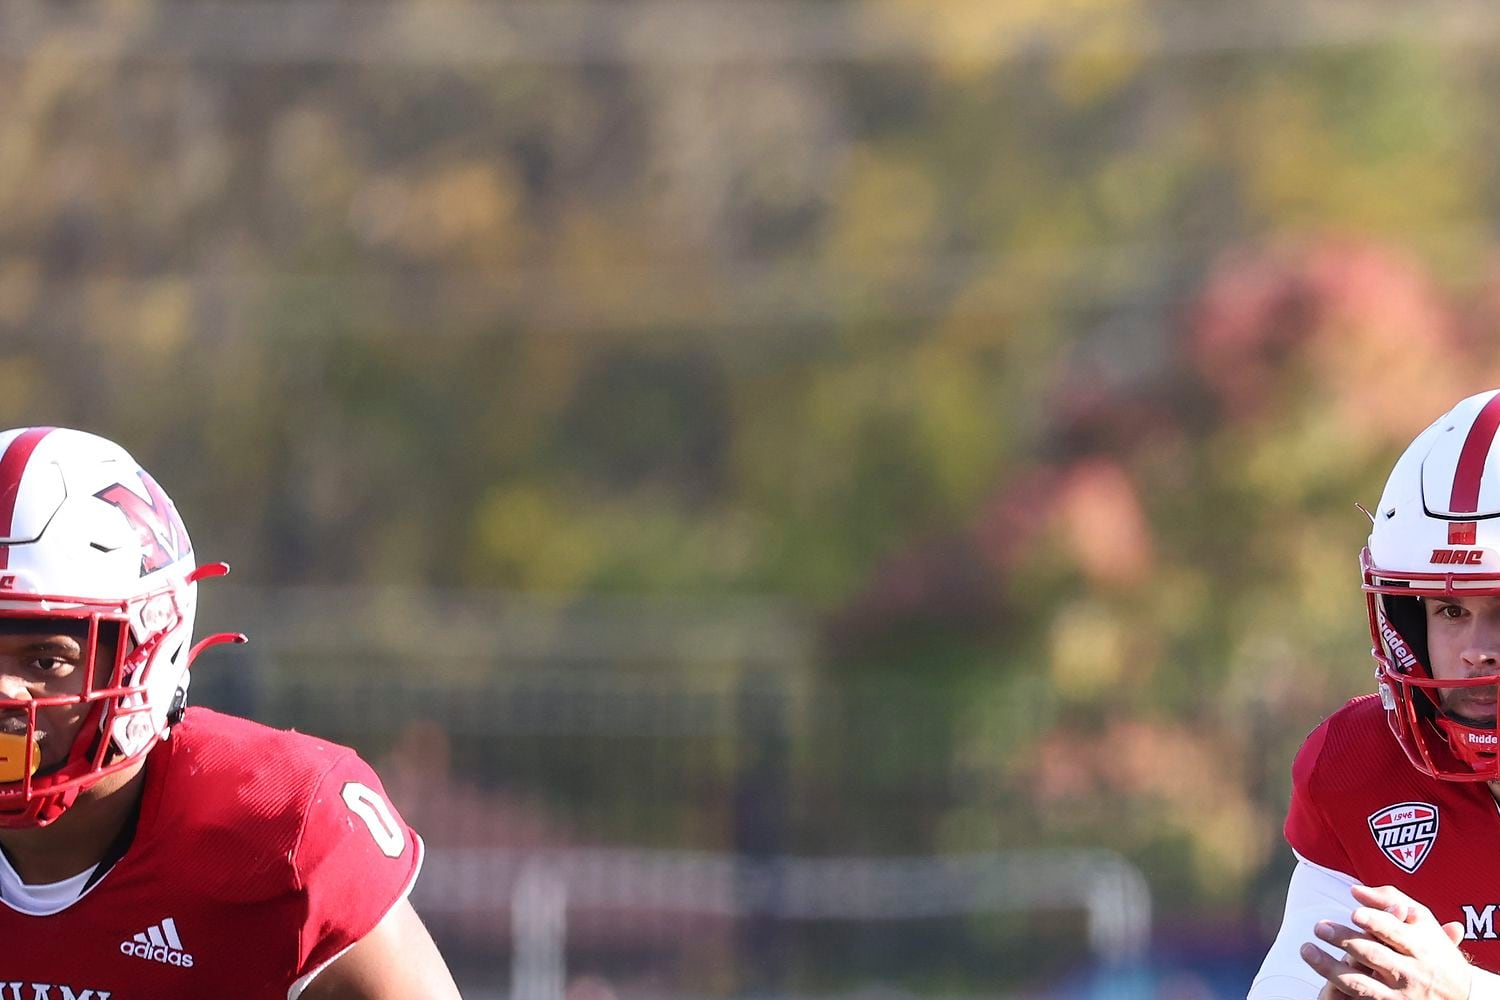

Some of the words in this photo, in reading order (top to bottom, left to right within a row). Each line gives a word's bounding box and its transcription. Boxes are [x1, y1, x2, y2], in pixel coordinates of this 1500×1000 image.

[1430, 549, 1483, 565] MAC
[340, 781, 405, 858] 0
[1378, 821, 1436, 846] MAC
[120, 939, 194, 968] adidas
